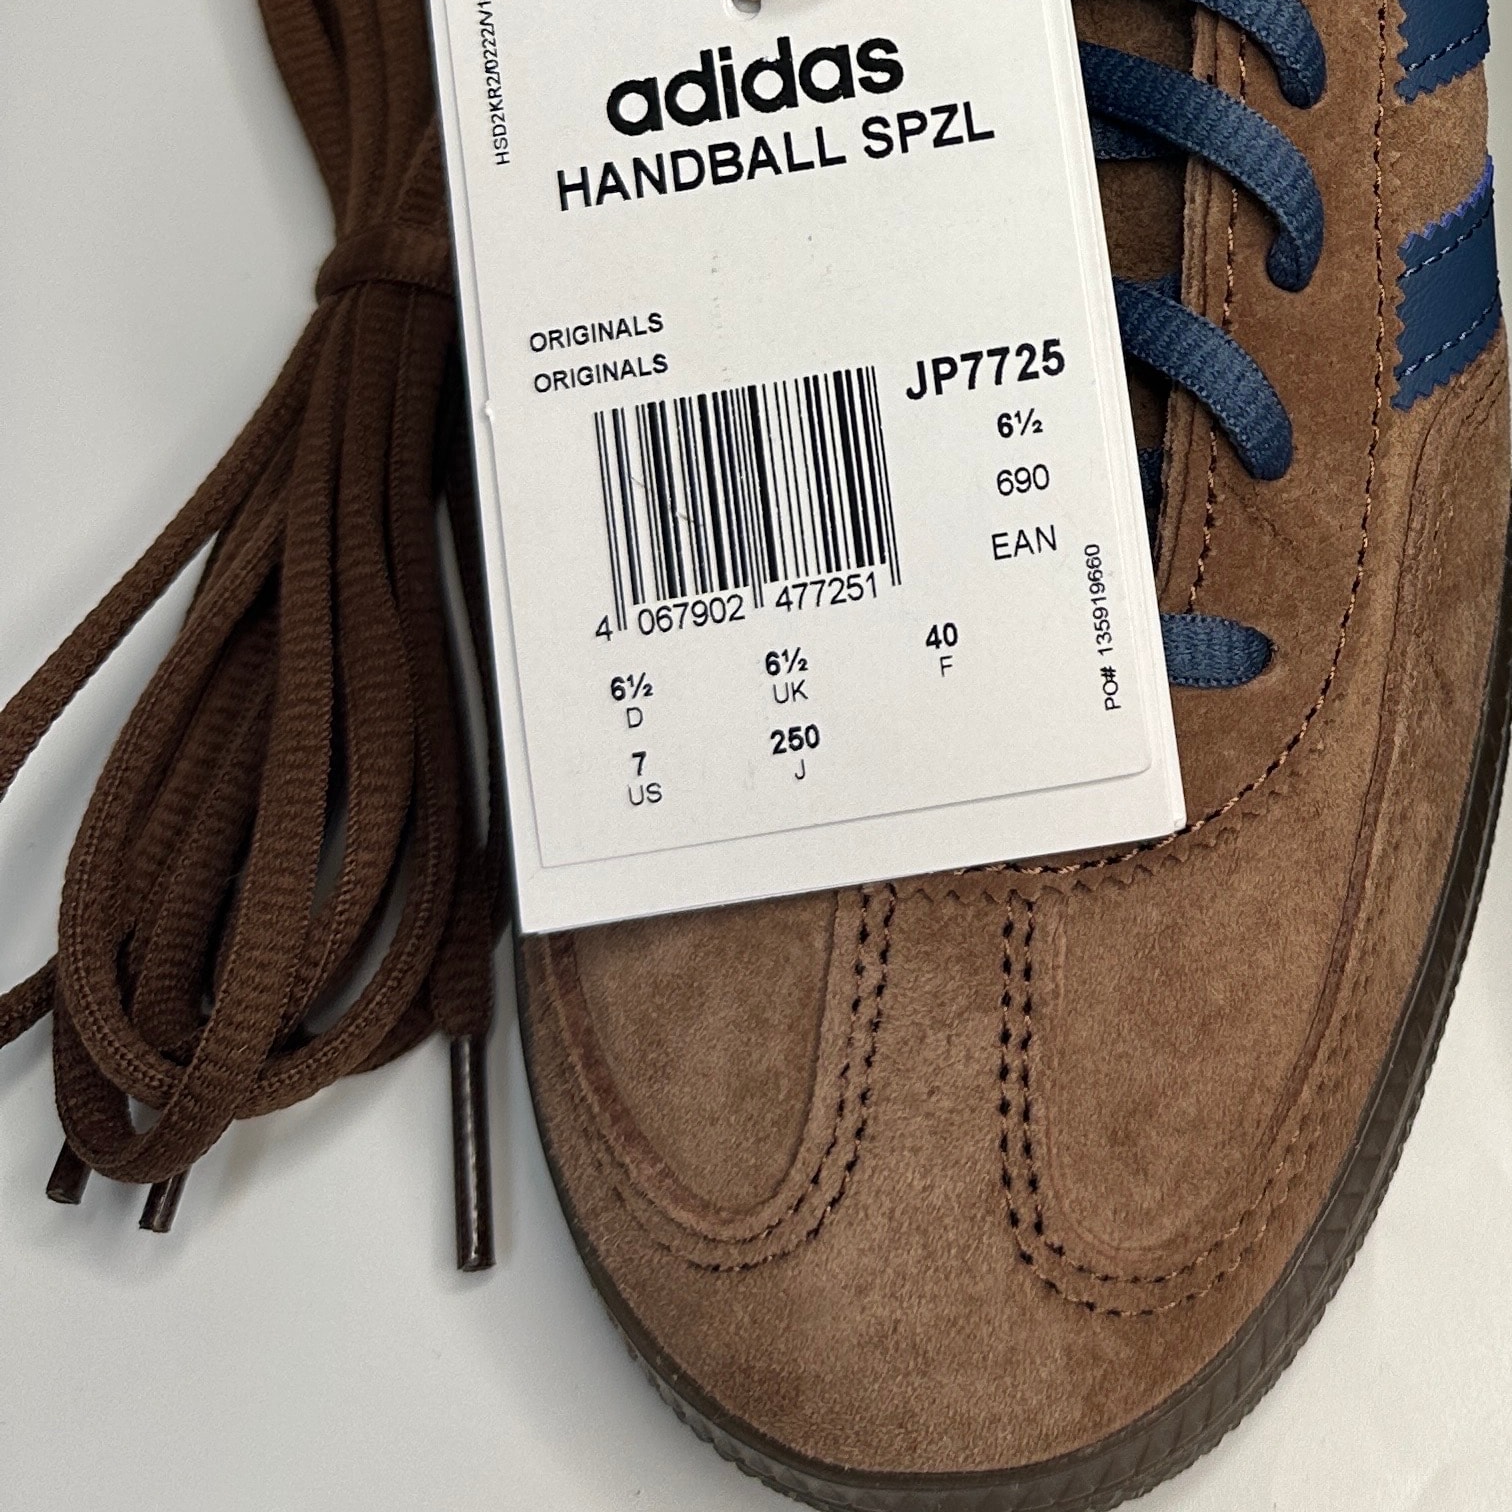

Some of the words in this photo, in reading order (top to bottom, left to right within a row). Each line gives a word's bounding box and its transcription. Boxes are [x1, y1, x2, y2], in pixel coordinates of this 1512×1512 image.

[606, 35, 904, 137] adidas
[556, 126, 846, 211] HANDBALL
[862, 101, 994, 159] SPZL
[530, 313, 663, 355] ORIGINALS
[533, 354, 668, 393] ORIGINALS
[906, 339, 1065, 400] JP7725
[997, 464, 1049, 496] 690
[992, 525, 1056, 560] EAN
[596, 615, 613, 641] 4
[637, 593, 745, 635] 067902
[774, 571, 877, 613] 477251
[1085, 544, 1112, 655] 135919660
[926, 623, 958, 649] 40
[940, 656, 952, 676] F
[774, 680, 808, 704] UK
[1100, 666, 1121, 710] PO#
[627, 707, 643, 728] D
[771, 724, 819, 755] 250
[632, 751, 646, 776] 7
[795, 760, 805, 780] J
[629, 783, 662, 805] US
